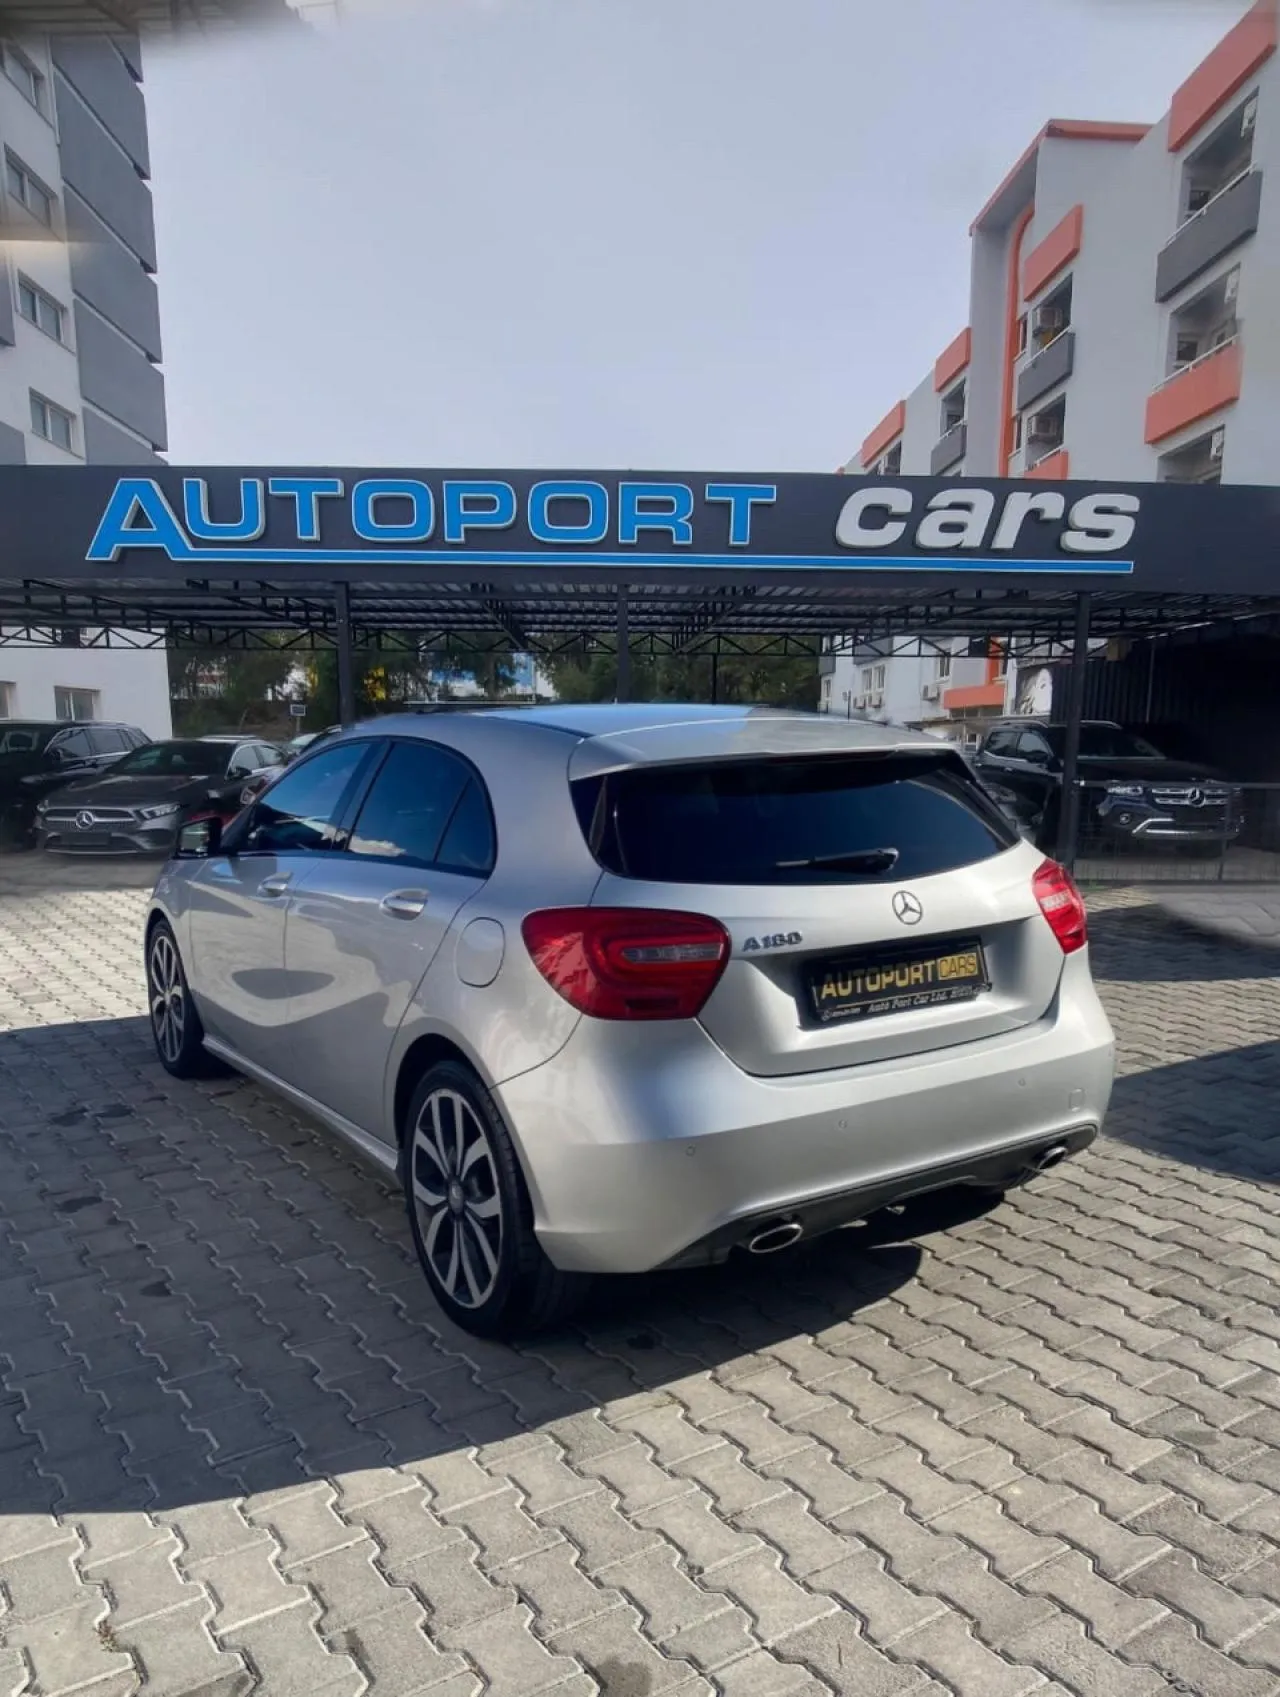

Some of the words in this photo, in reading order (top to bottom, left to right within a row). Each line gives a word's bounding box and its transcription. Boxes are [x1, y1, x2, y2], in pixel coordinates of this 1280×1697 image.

[85, 477, 778, 561] AUTOPORT
[835, 486, 1141, 553] cars
[821, 961, 936, 1000] AUTOPORT
[938, 954, 978, 980] CARS
